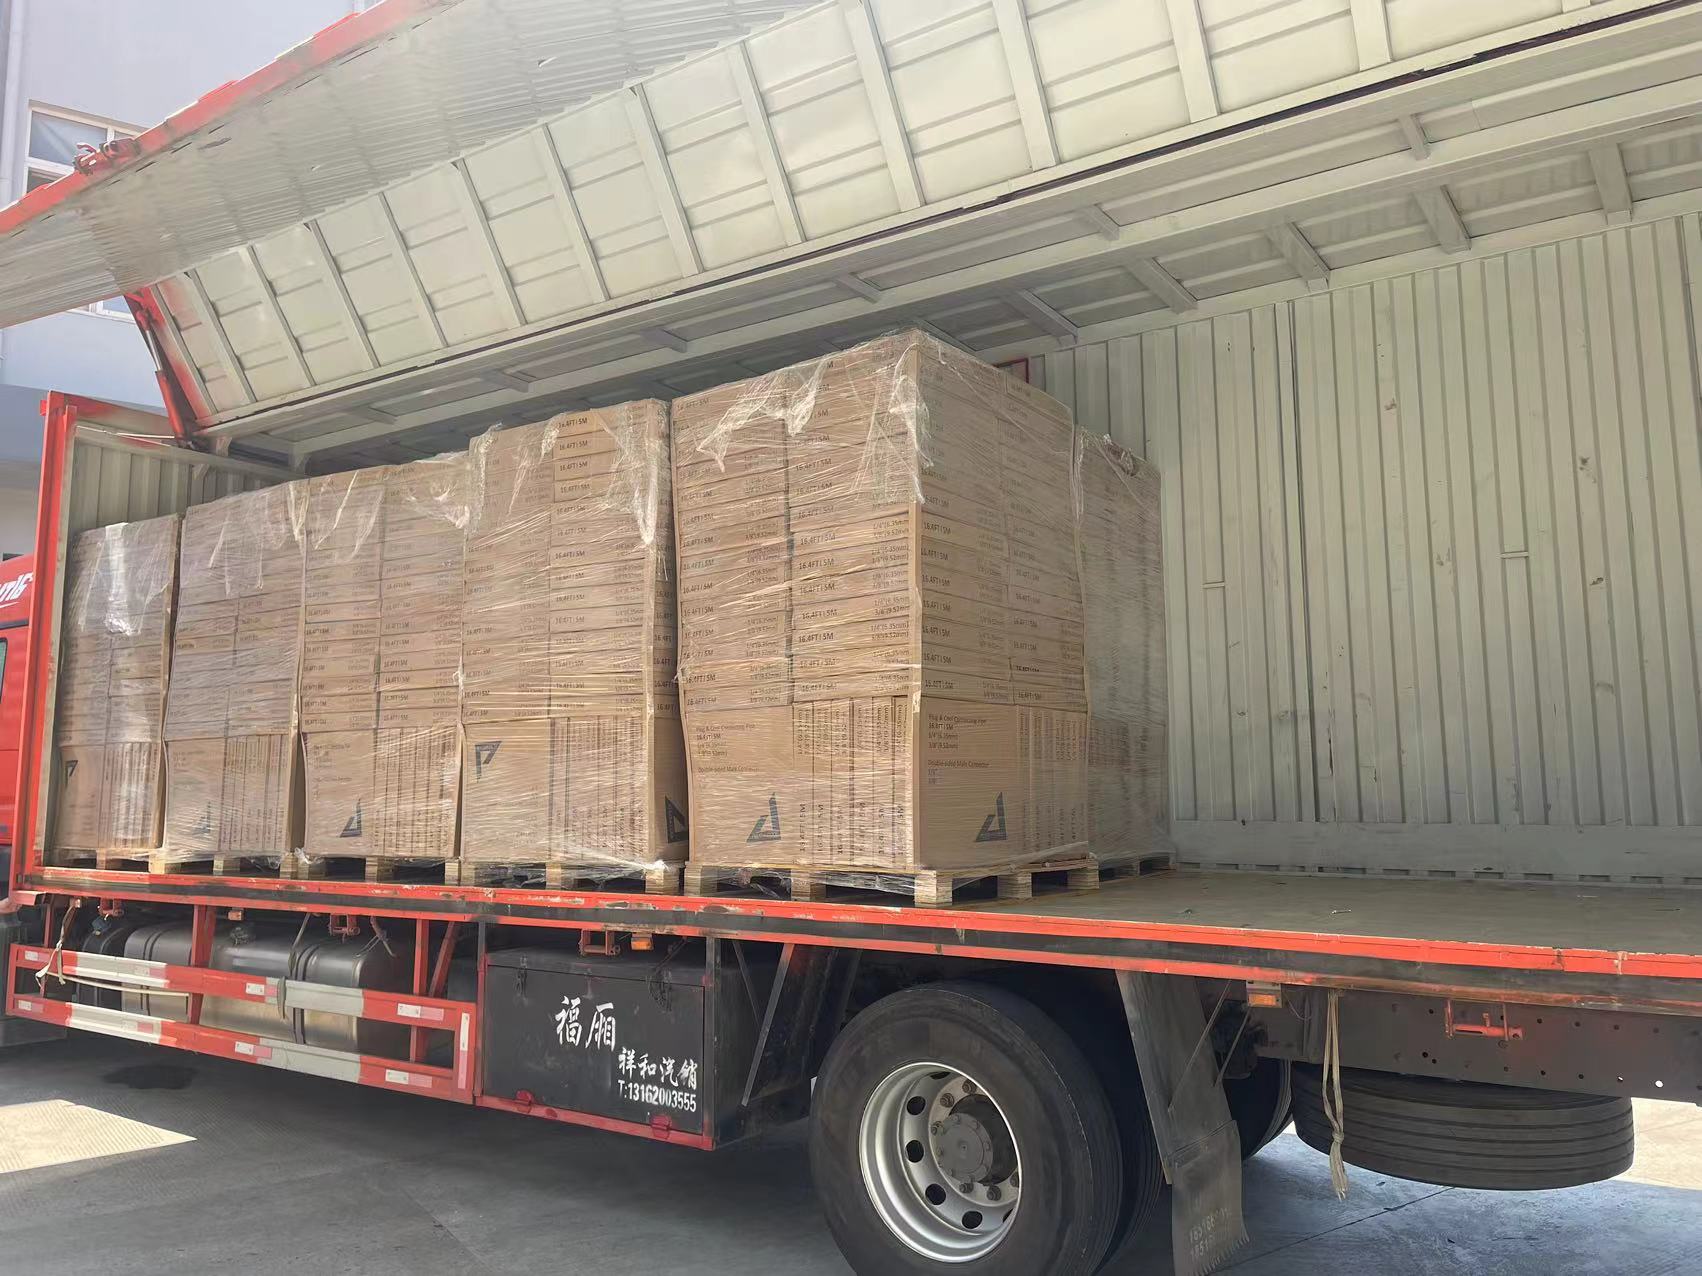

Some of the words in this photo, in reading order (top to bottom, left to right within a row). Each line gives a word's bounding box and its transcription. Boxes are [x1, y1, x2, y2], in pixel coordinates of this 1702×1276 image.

[618, 1047, 698, 1090] 祥和汽销
[618, 1079, 696, 1112] T:13162003555
